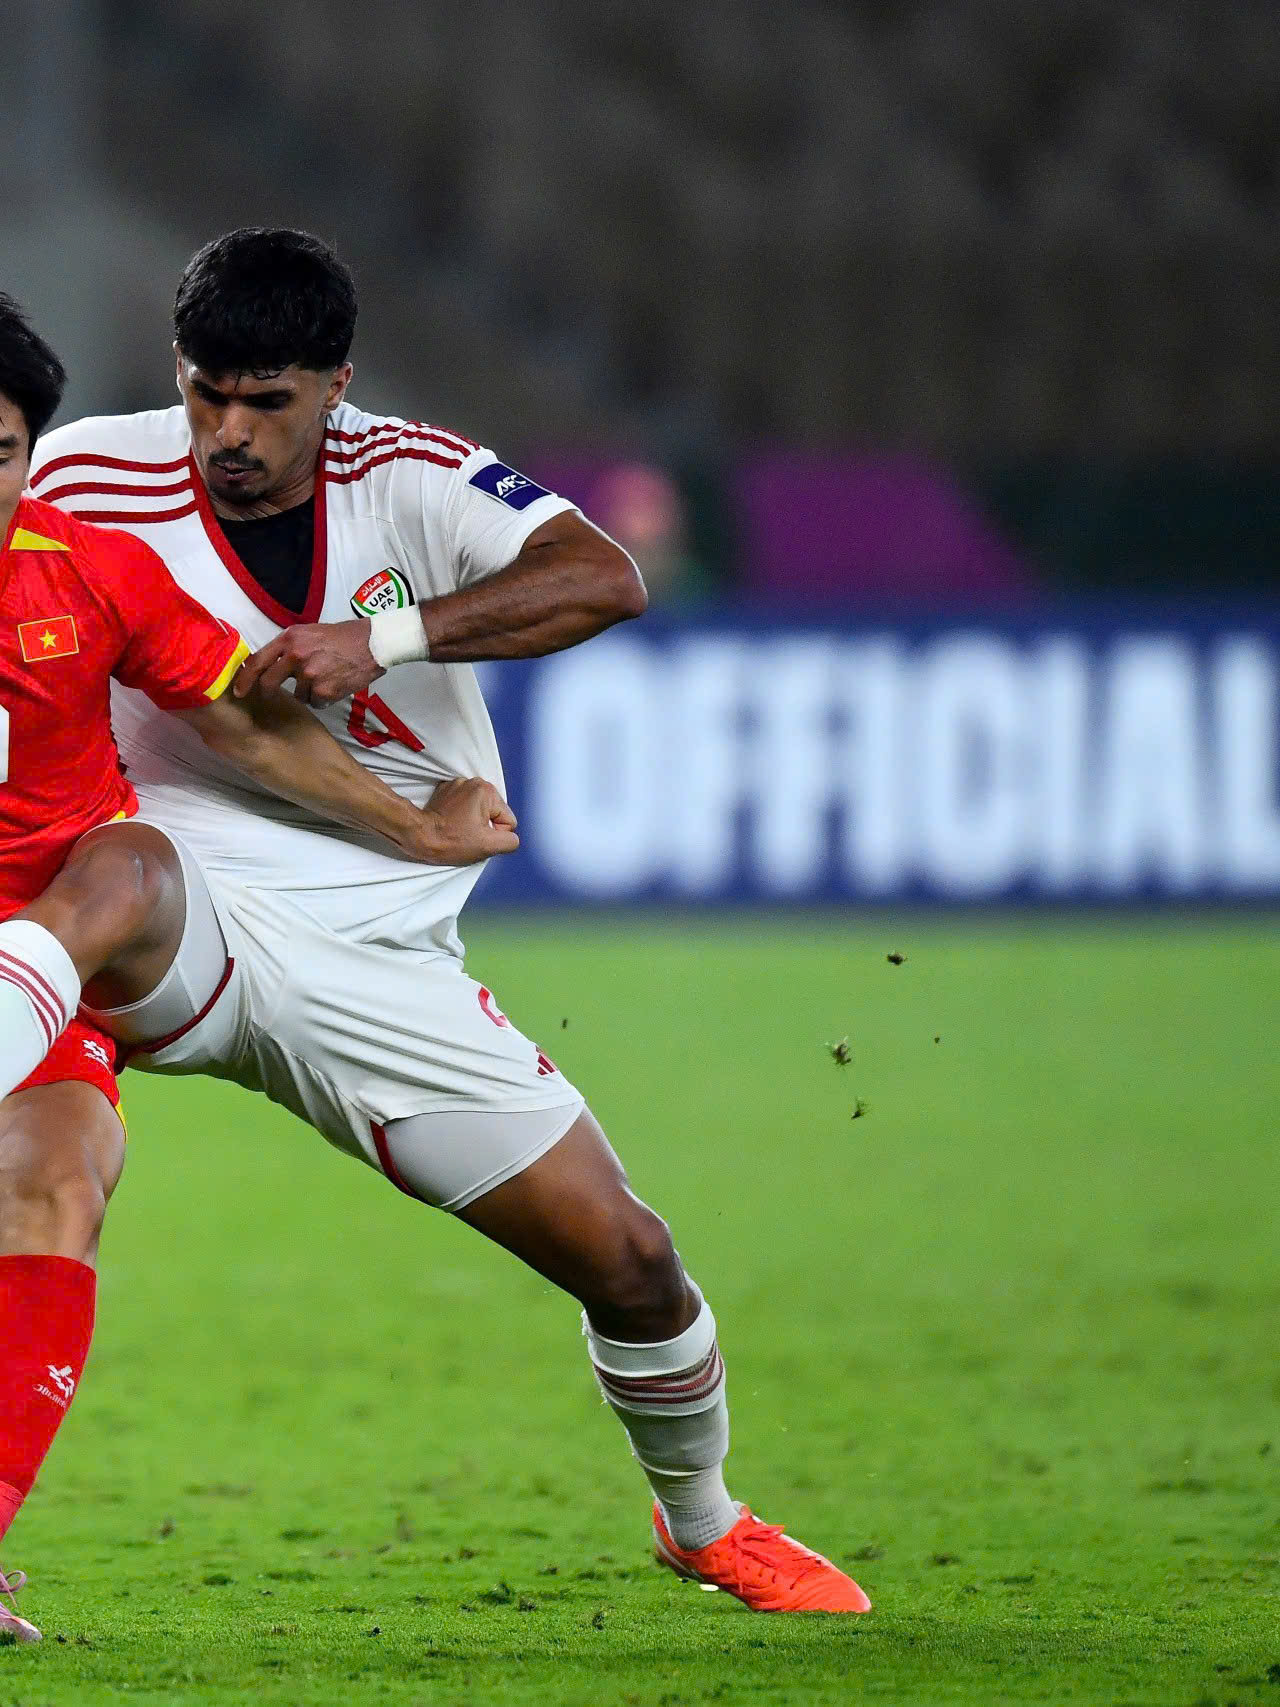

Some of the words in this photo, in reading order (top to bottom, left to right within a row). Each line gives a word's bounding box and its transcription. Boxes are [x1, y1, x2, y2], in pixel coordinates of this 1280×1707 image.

[495, 474, 527, 497] AFC
[368, 585, 394, 608] UAE
[380, 597, 395, 611] FA
[532, 628, 1280, 892] OFFICIAL
